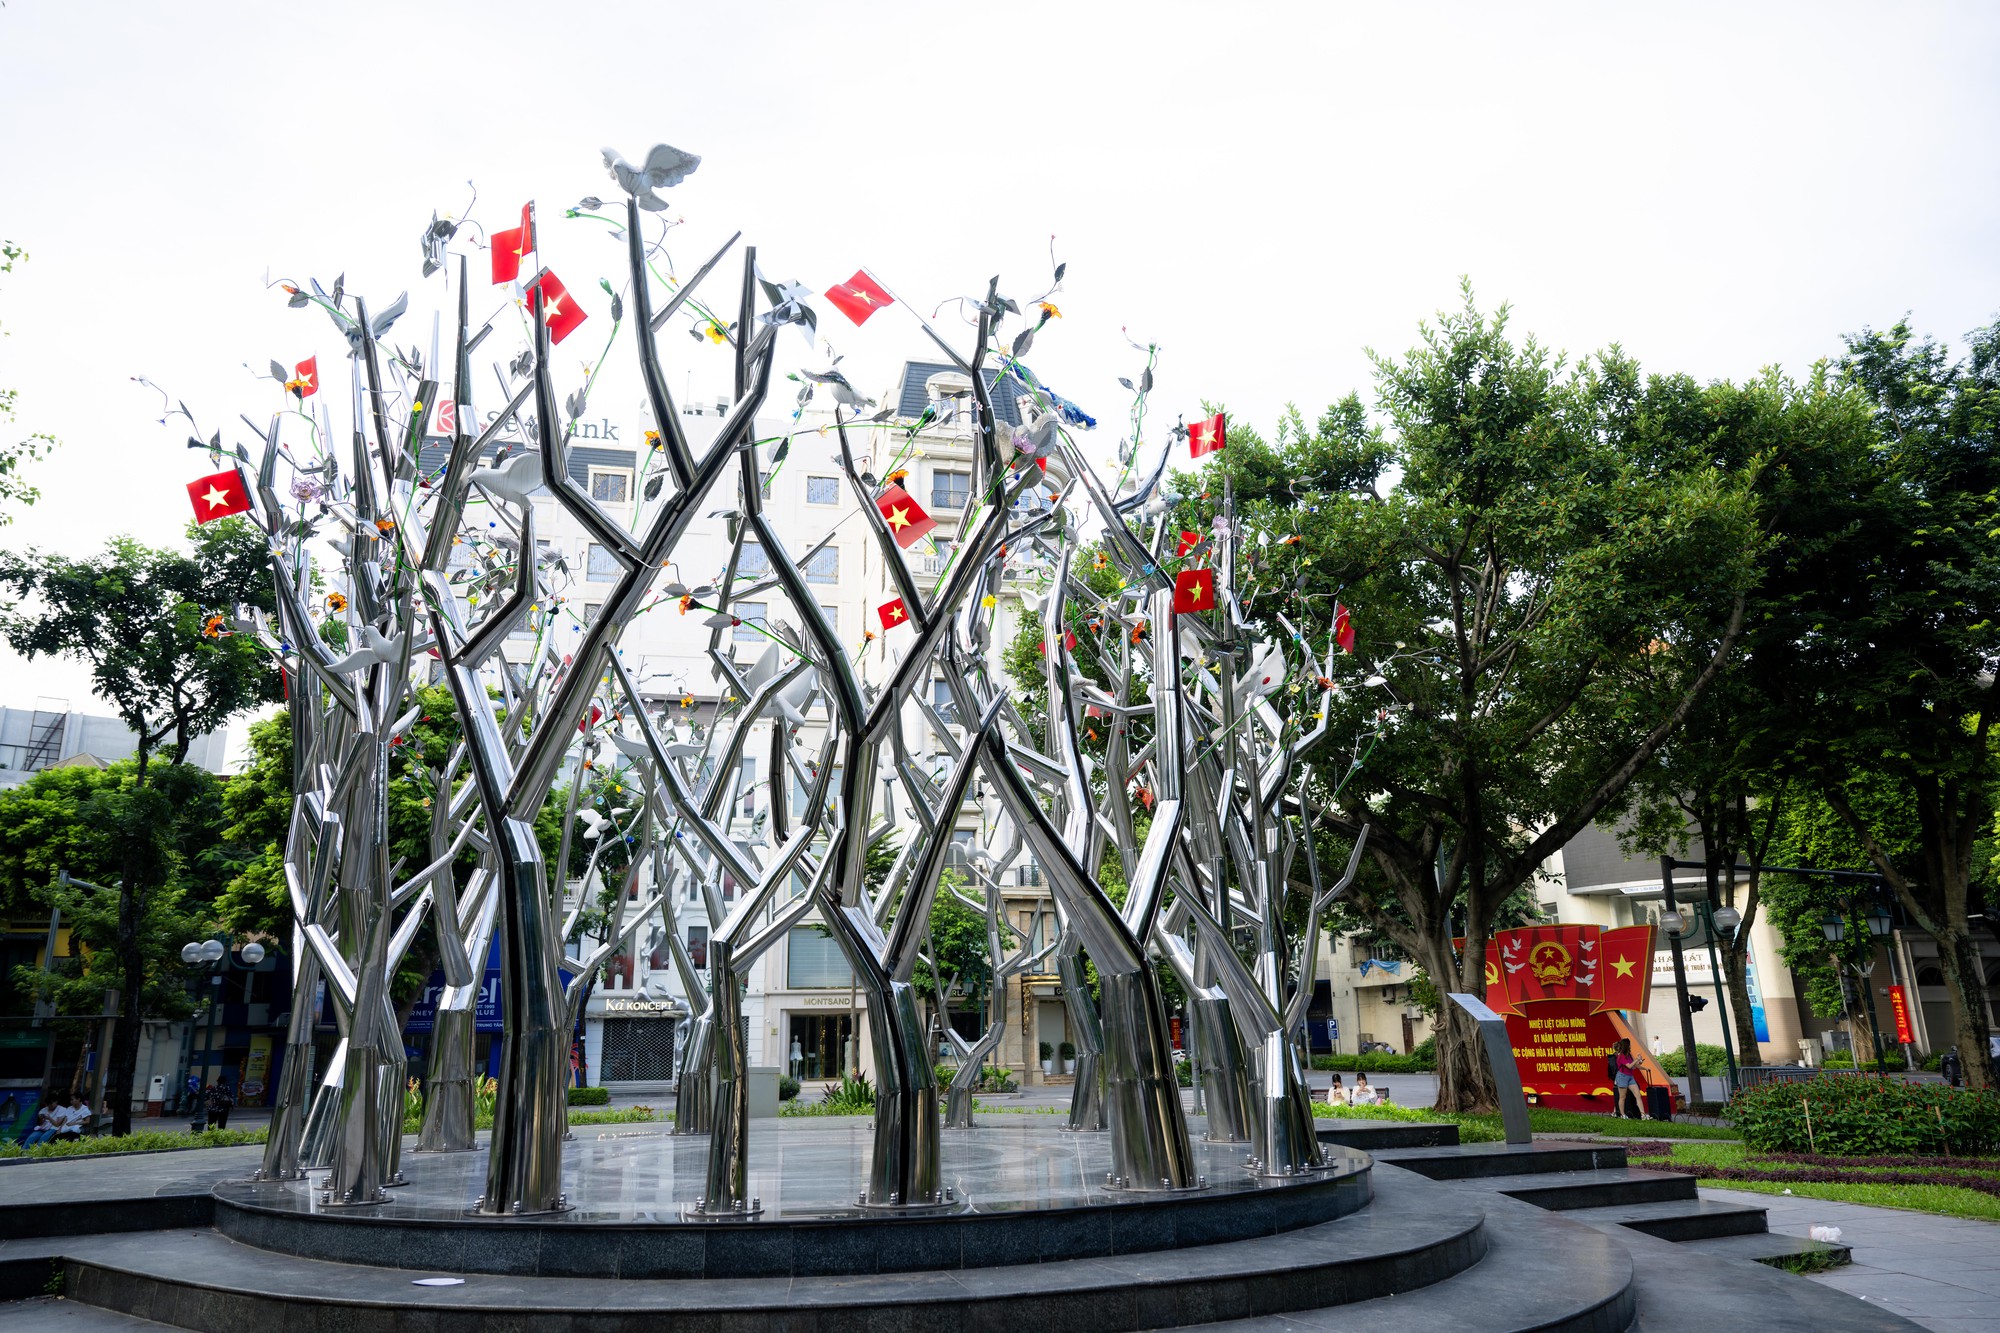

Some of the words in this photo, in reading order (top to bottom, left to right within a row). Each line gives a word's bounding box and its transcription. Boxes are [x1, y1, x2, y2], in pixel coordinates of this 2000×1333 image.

[626, 1001, 674, 1011] KONCEPT
[804, 997, 851, 1006] MONTSAND
[1330, 1020, 1335, 1028] P
